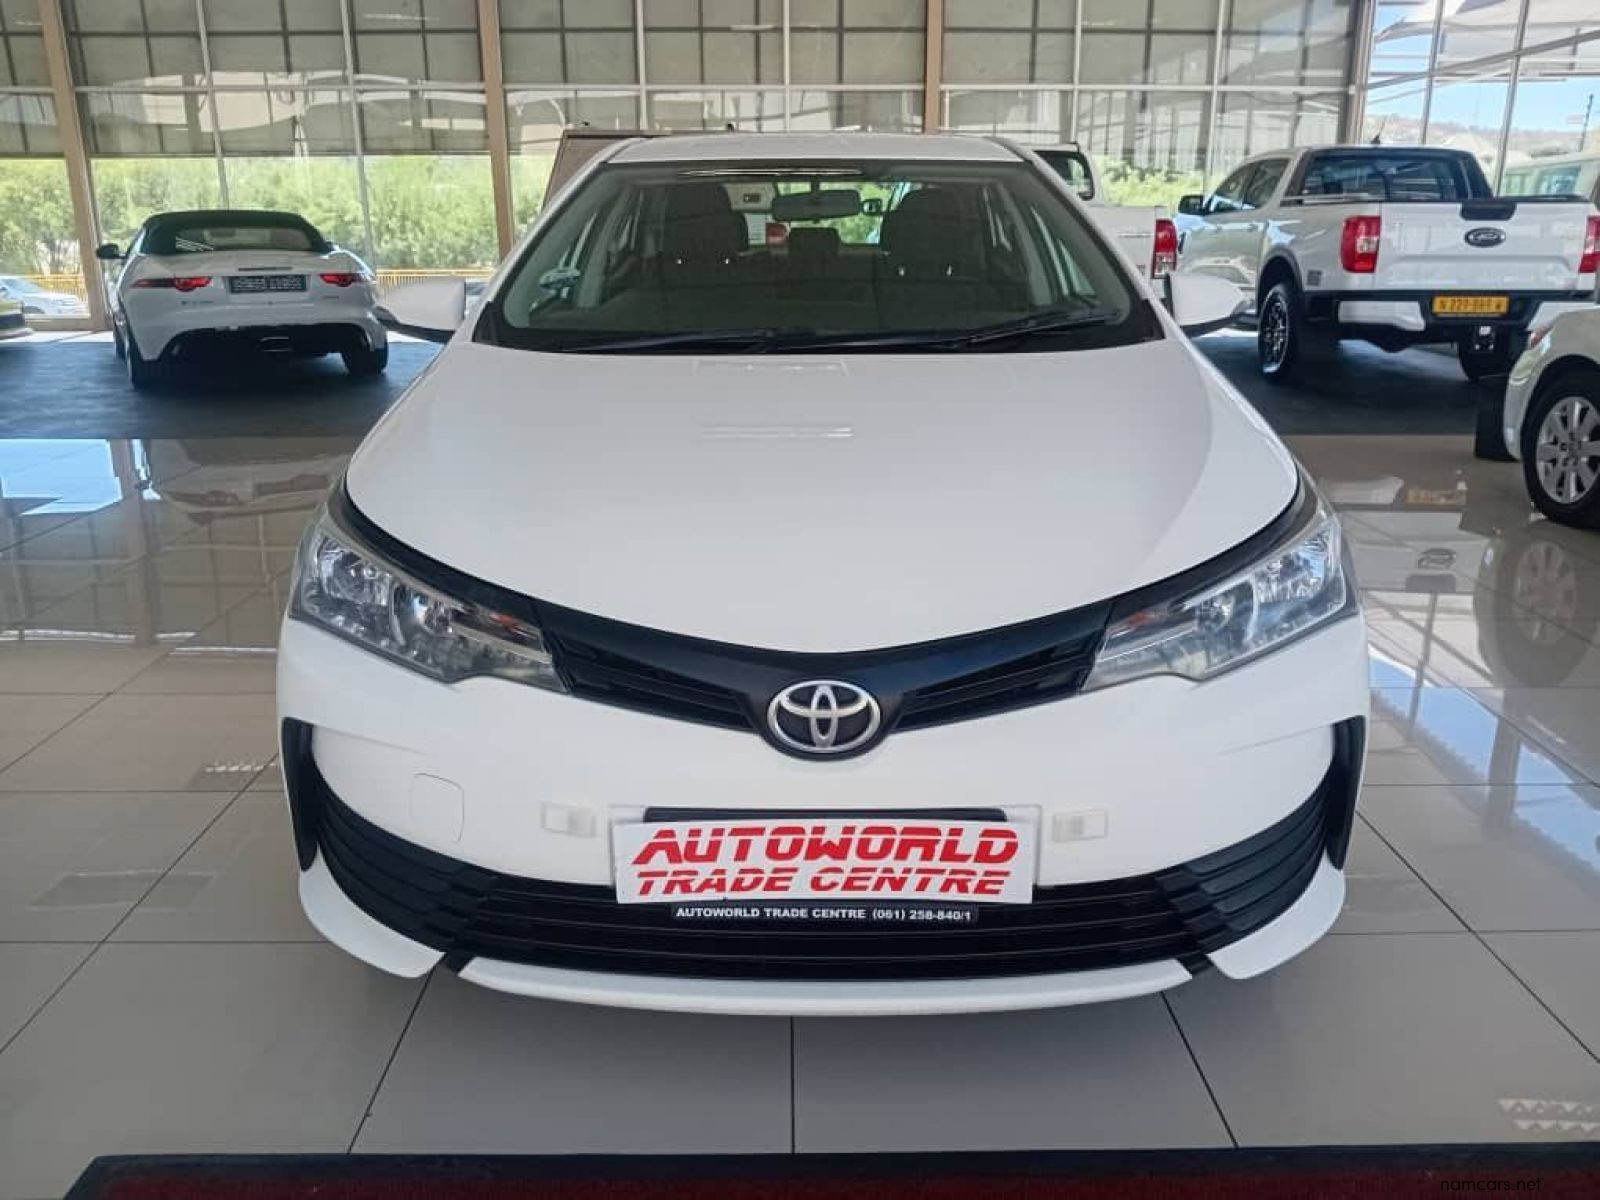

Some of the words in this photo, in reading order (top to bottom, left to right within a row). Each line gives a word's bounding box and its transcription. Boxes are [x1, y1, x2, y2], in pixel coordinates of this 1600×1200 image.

[632, 826, 1018, 864] AUTOWORLD
[637, 868, 797, 896] TRADE
[810, 867, 1011, 895] CENTRE
[676, 907, 760, 917] AUTOWORLD
[763, 907, 808, 918] TRADE
[812, 907, 866, 919] CENTRE
